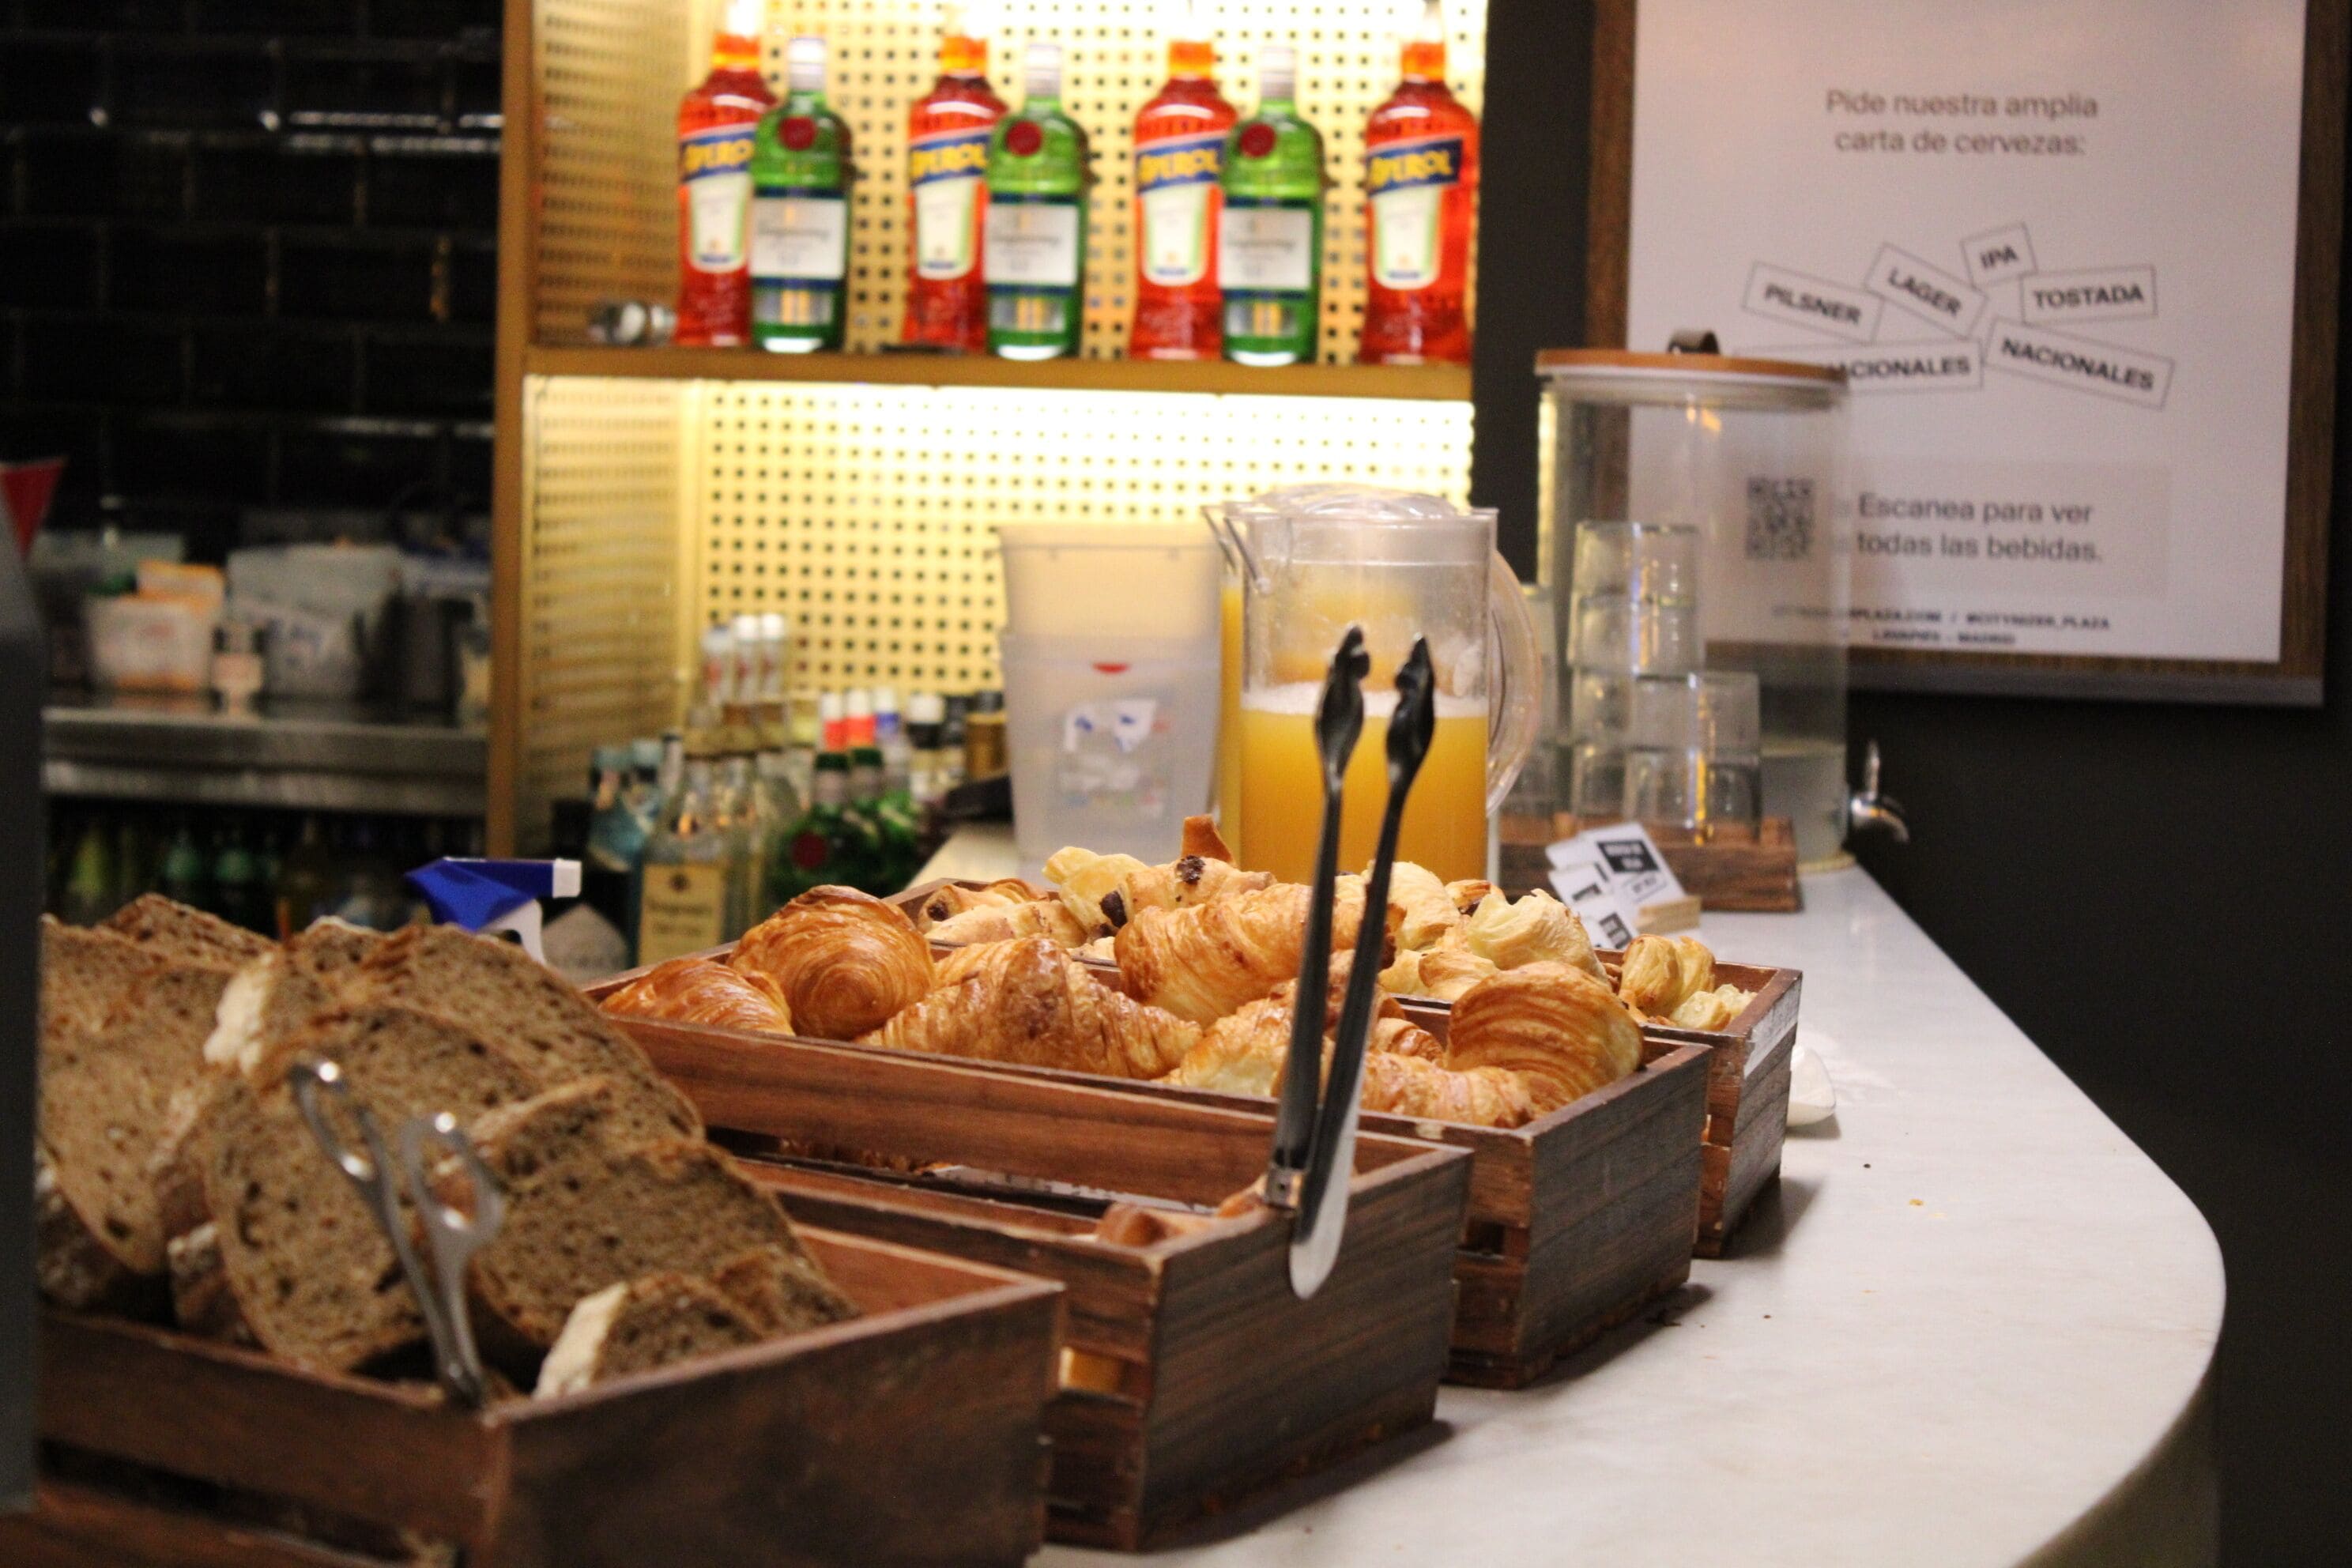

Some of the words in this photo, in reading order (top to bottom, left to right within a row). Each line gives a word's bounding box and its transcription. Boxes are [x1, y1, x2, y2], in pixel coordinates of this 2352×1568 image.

[1826, 89, 1886, 115] Pide
[1893, 93, 1998, 117] nuestra
[2004, 92, 2099, 121] amplia
[1834, 130, 1905, 153] carta
[1911, 130, 1948, 154] de
[1980, 245, 2019, 270] IPA
[1763, 282, 1862, 324] PILSNER
[1887, 269, 1962, 317] LAGER
[2034, 284, 2144, 309] TOSTADA
[2001, 337, 2154, 390] NACIONALES
[1859, 492, 1975, 522] Escanea
[1982, 502, 2044, 526] para
[2050, 503, 2093, 524] ver
[1857, 530, 1933, 556] todas
[1939, 533, 1980, 558] las
[1986, 534, 2102, 563] bebidas.
